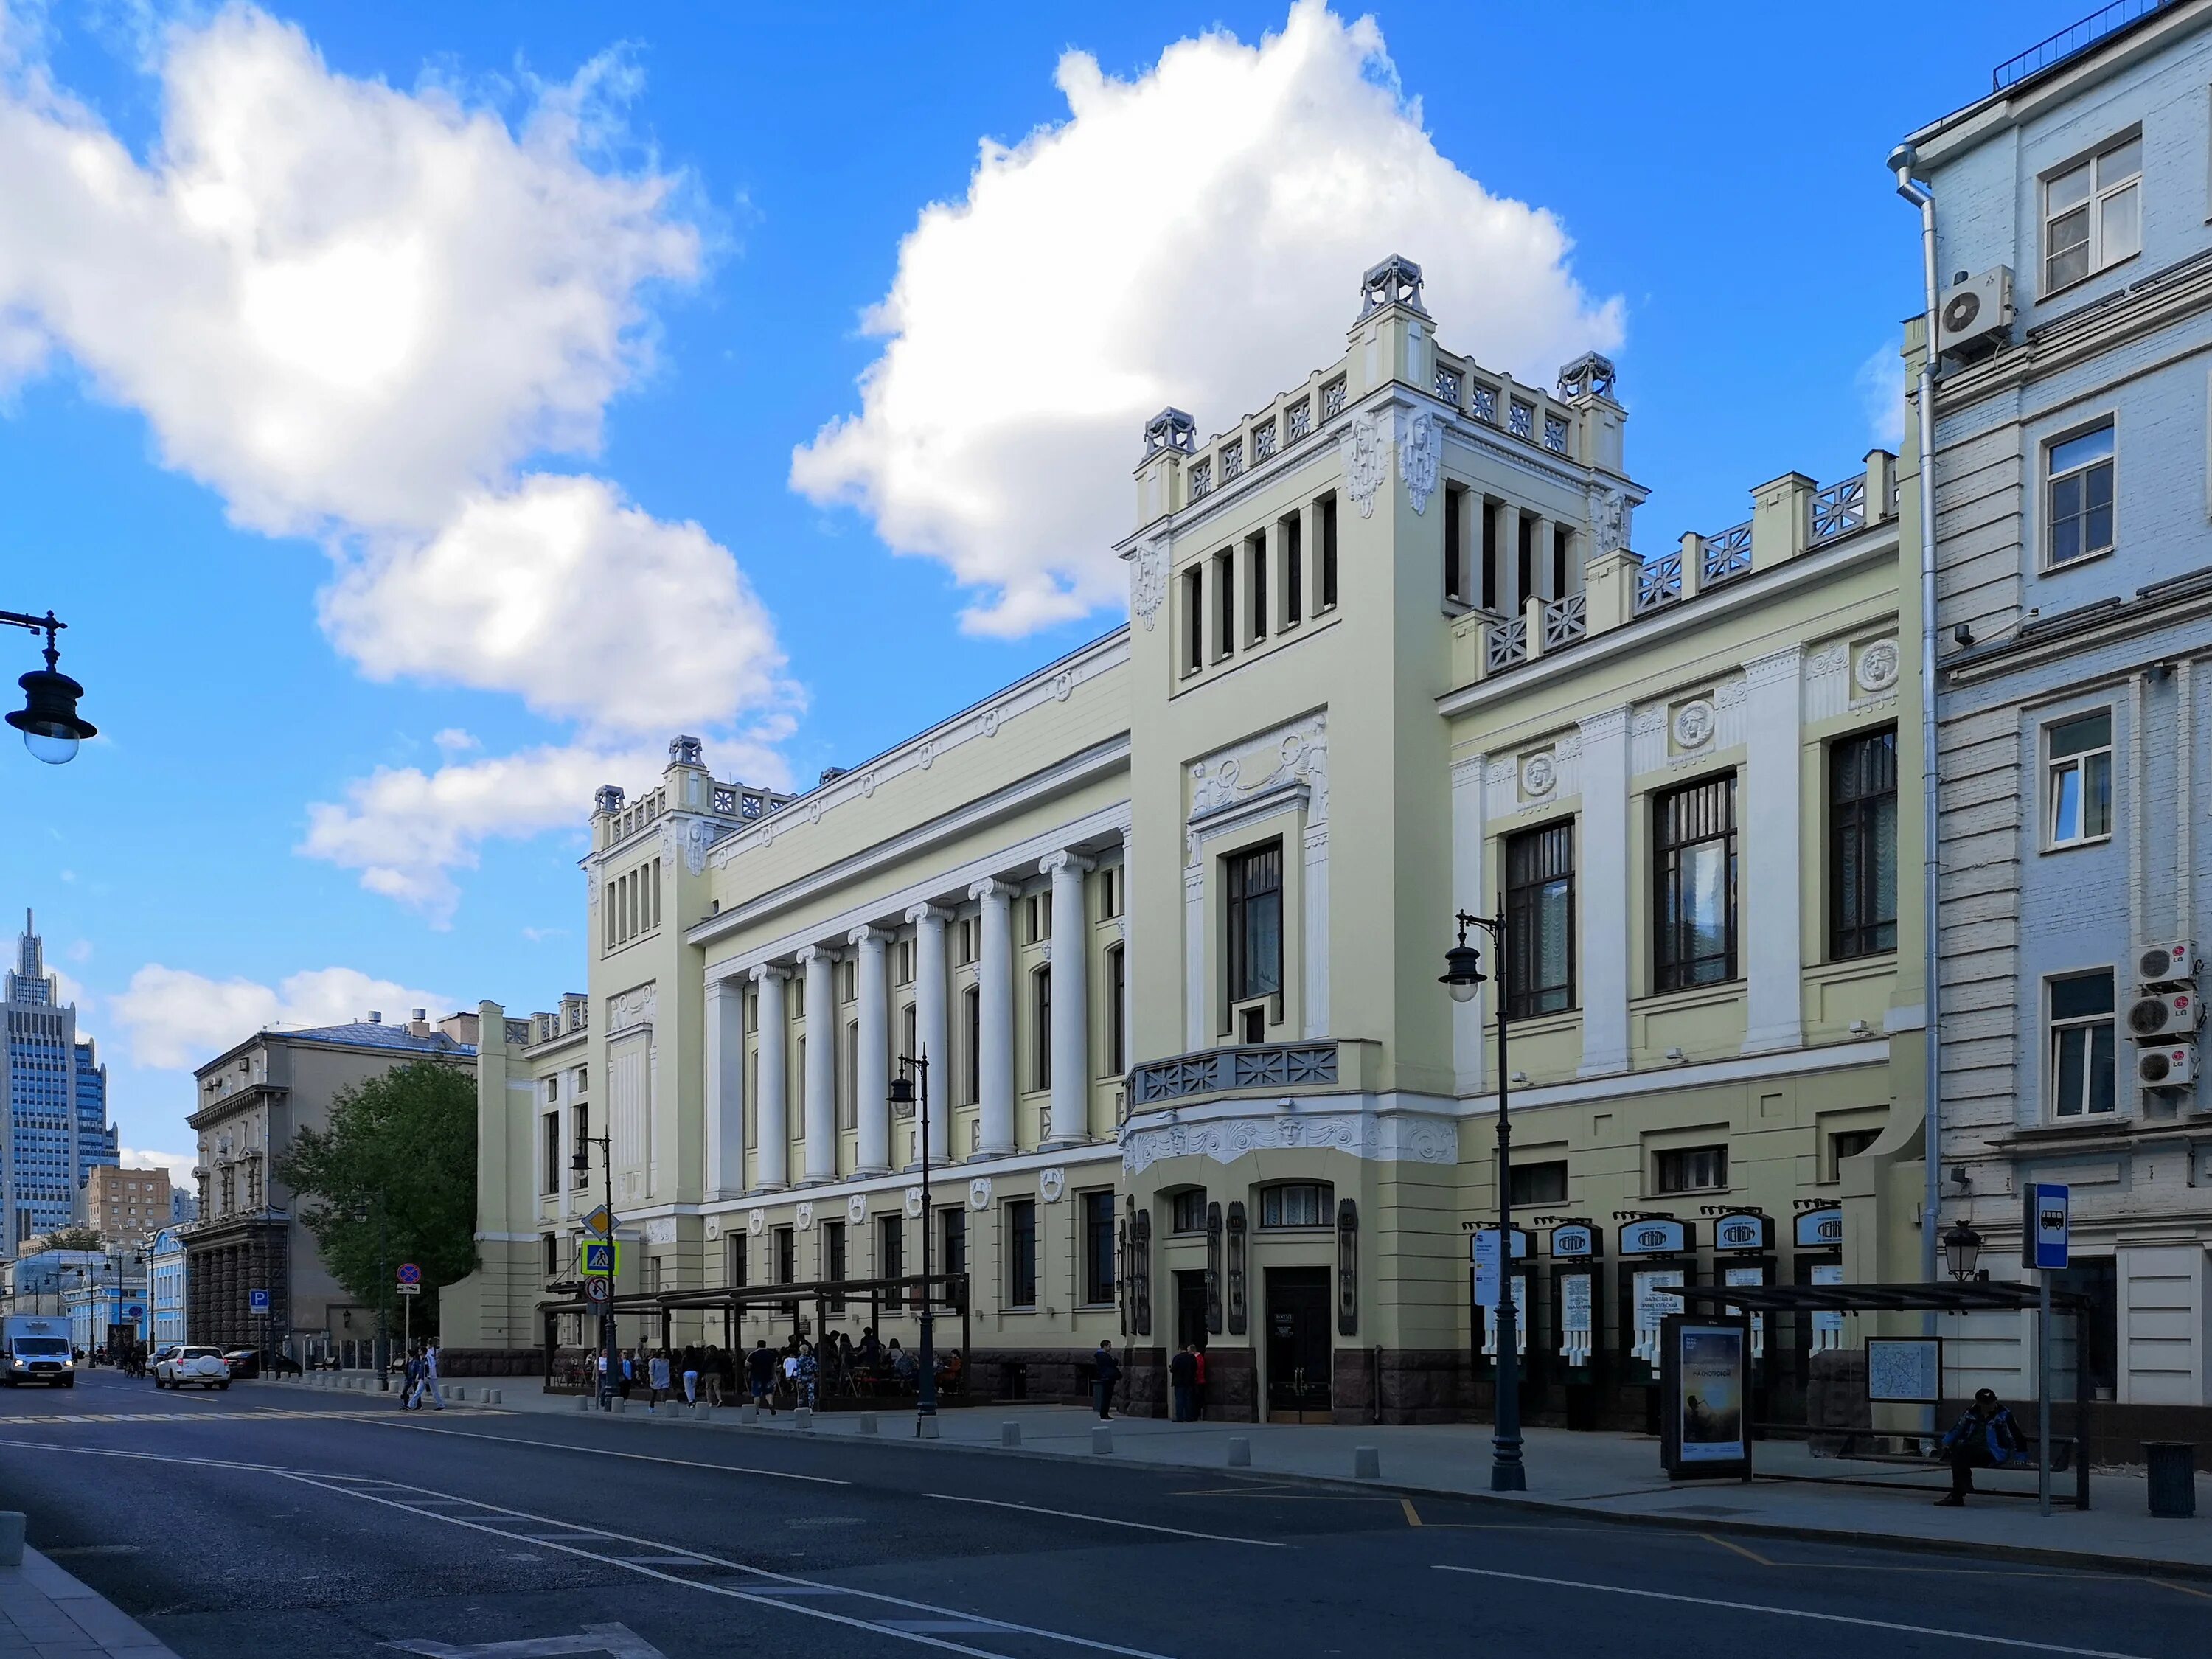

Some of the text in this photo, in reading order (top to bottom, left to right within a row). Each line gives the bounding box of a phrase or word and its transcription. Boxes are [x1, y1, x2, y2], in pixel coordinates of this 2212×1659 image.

[1723, 1226, 1756, 1242] ЛЕНКОМ
[1818, 1220, 1842, 1237] ЛЕНК
[1559, 1235, 1585, 1251] ЛЕНКОМ
[1638, 1231, 1666, 1246] ЛЕНКОМ
[255, 1292, 265, 1304] P
